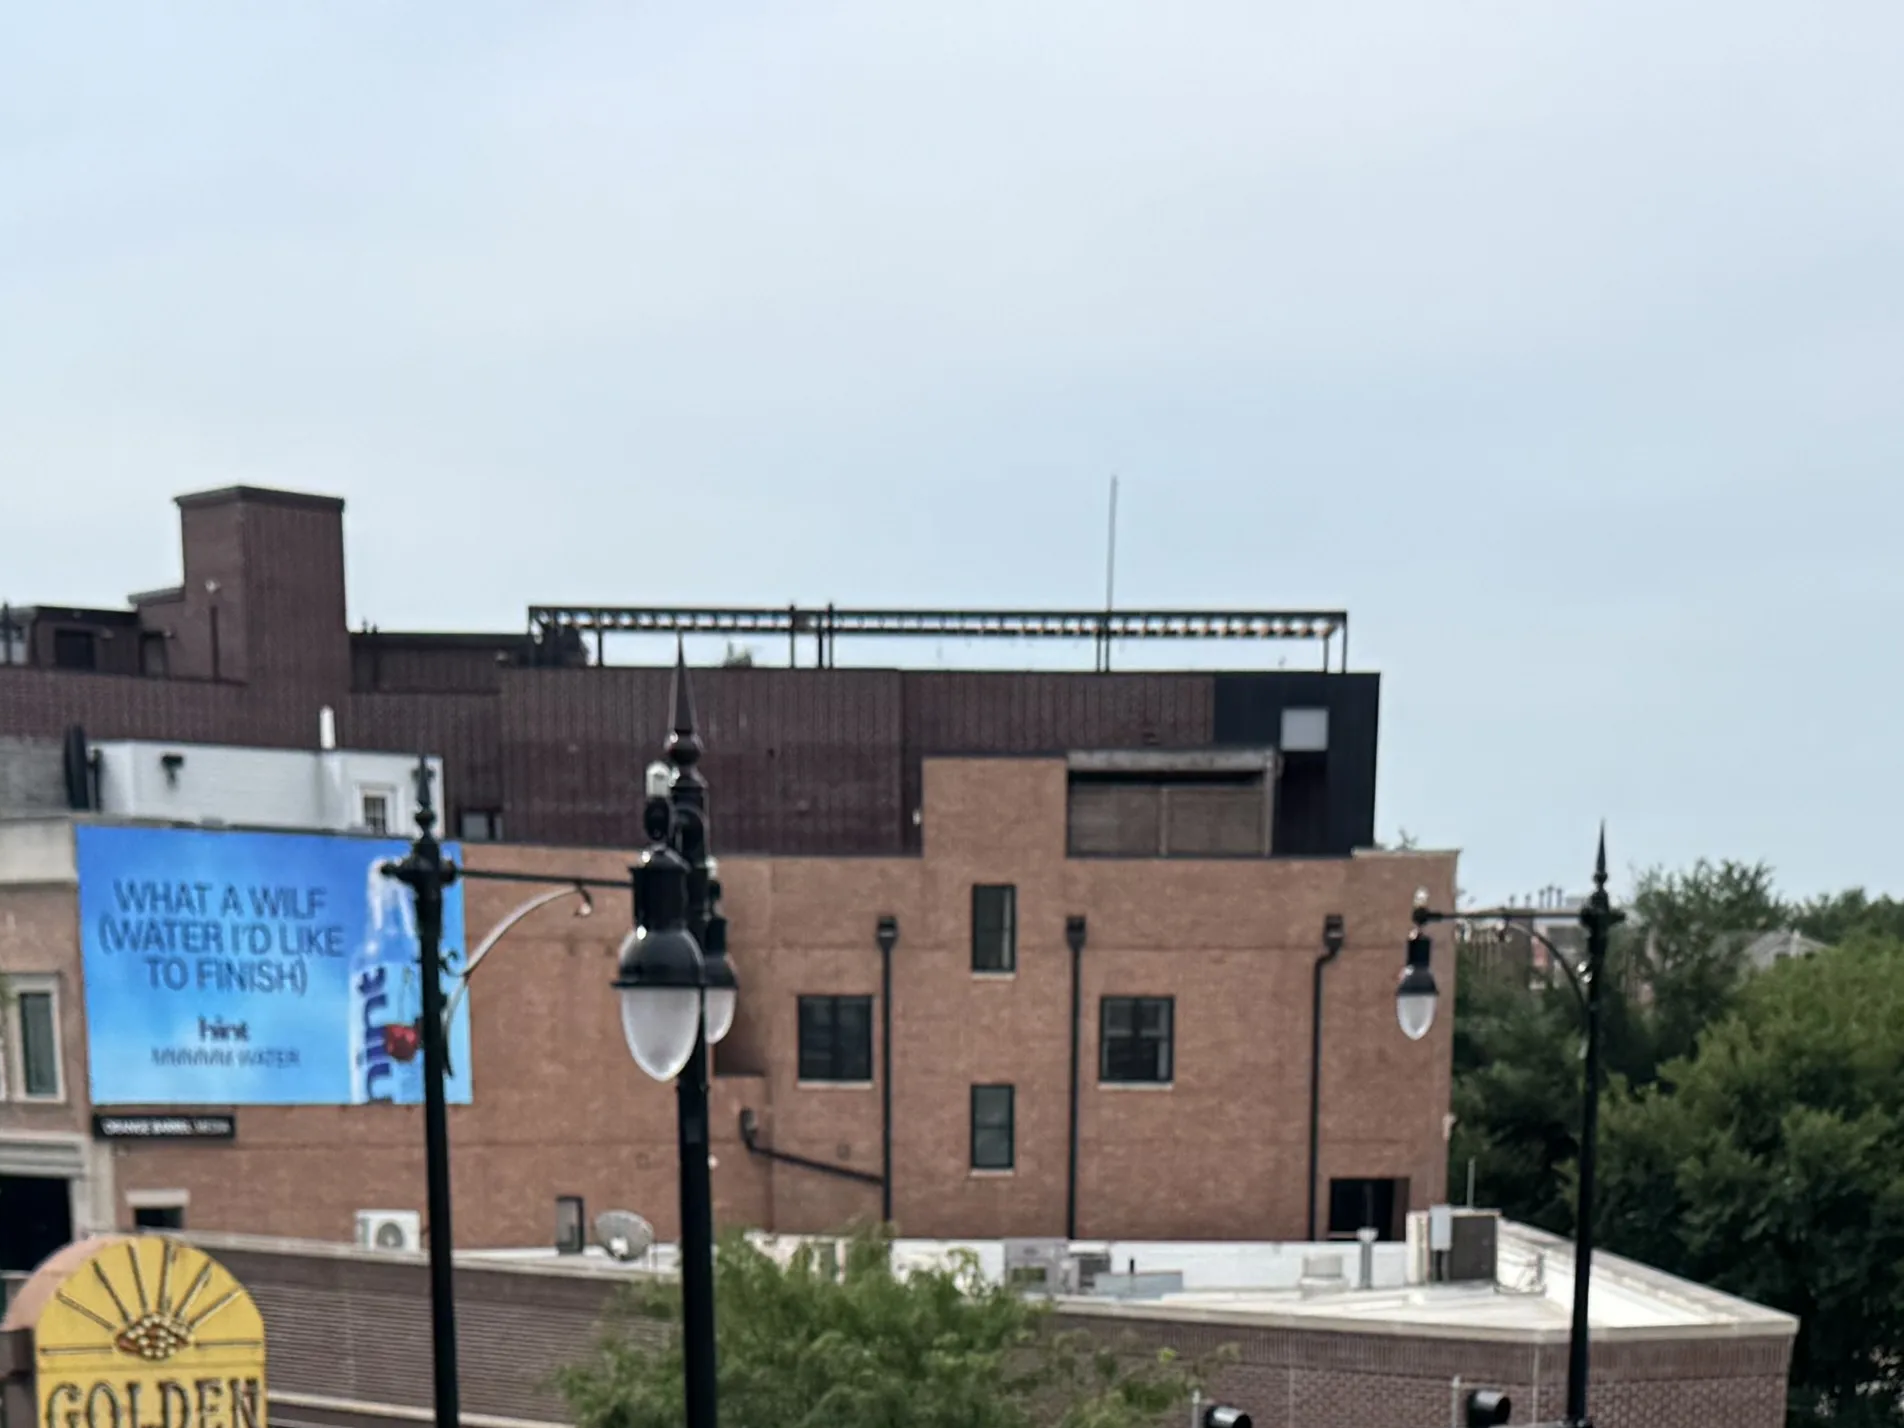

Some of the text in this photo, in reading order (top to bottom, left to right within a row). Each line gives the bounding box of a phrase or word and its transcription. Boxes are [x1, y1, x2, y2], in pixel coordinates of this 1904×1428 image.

[112, 879, 327, 921] WHAT A WILF
[98, 911, 346, 958] (WATER I'D LIKE
[144, 954, 309, 997] TO FINISH)
[198, 1015, 250, 1042] hint
